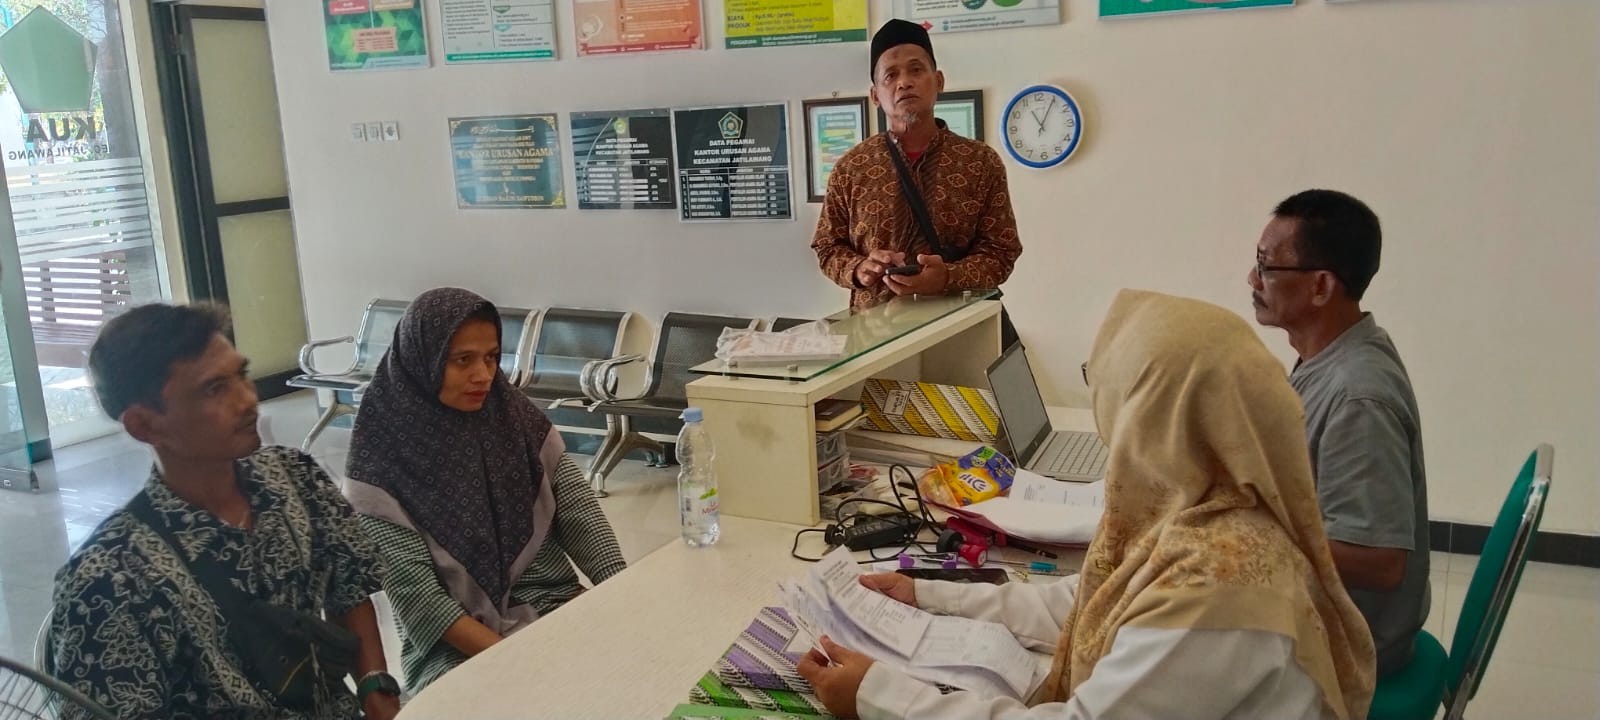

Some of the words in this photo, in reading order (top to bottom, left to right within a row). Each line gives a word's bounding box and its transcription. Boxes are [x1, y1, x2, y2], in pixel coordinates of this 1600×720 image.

[1034, 93, 1045, 102] 12
[1022, 98, 1029, 107] 11
[1062, 104, 1070, 113] 2
[1012, 111, 1021, 119] 10
[1066, 119, 1075, 127] 3
[1010, 126, 1018, 134] 9
[1064, 133, 1071, 142] 4
[709, 139, 726, 147] DATA
[726, 138, 756, 146] PEGAWAI
[1015, 140, 1023, 148] 8
[490, 148, 523, 158] URUSAN
[523, 147, 554, 157] AGAMA
[720, 147, 747, 155] URUSAN
[748, 146, 771, 154] AGAMA
[1026, 149, 1033, 158] 7
[1055, 146, 1062, 155] 5
[693, 157, 731, 165] KECAMATAN
[732, 155, 773, 163] JATILAWANG
[1040, 151, 1048, 160] 6
